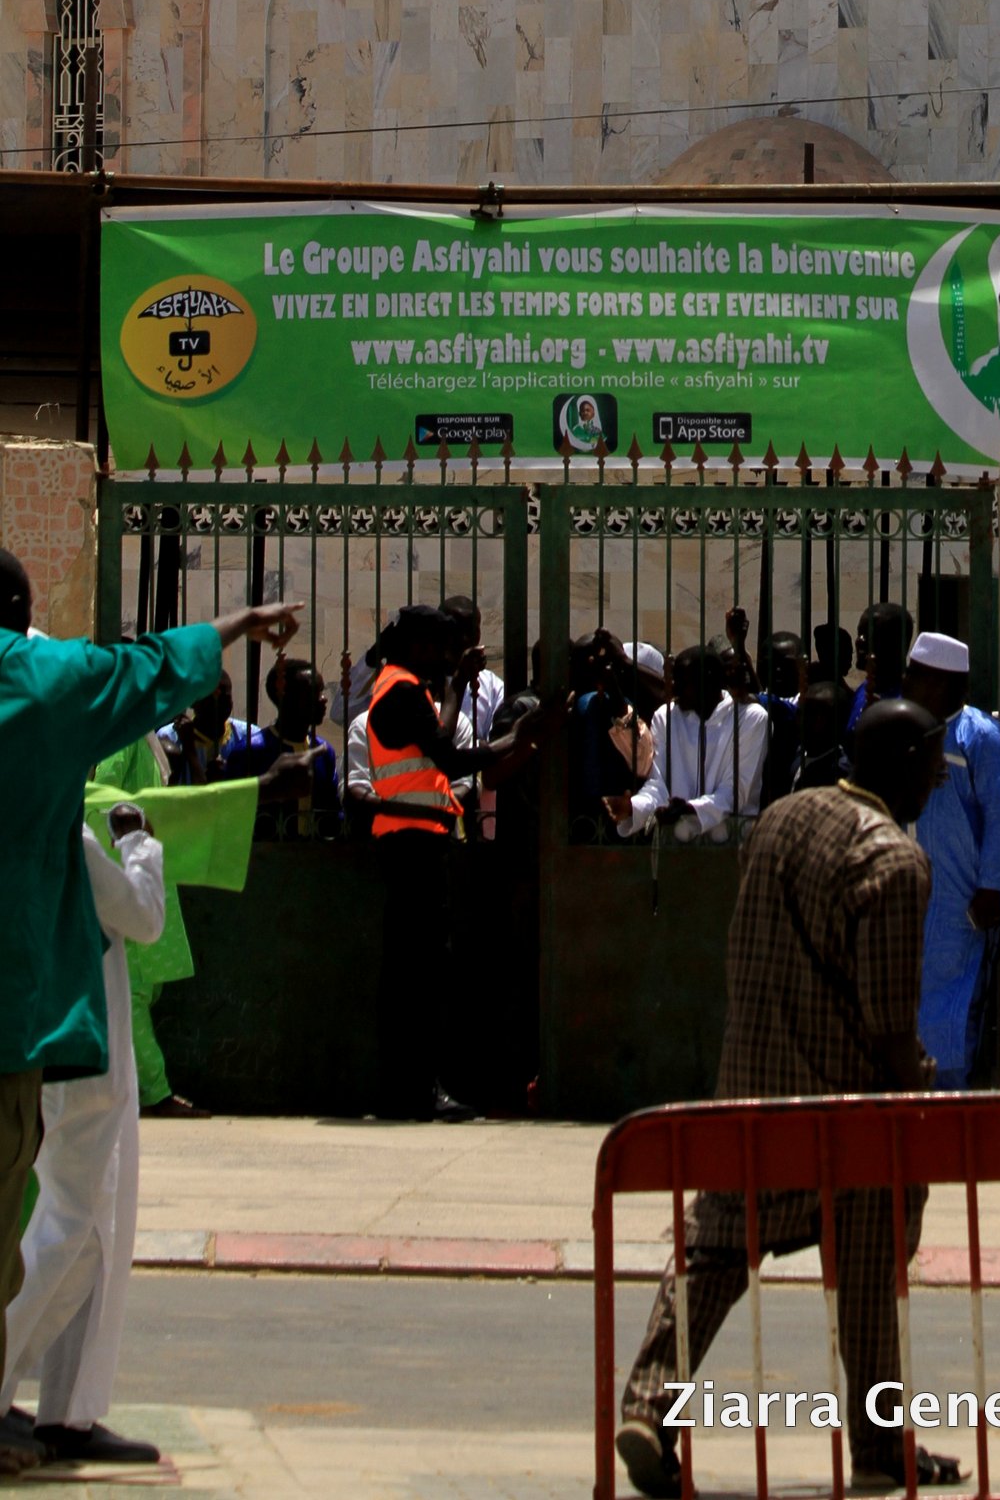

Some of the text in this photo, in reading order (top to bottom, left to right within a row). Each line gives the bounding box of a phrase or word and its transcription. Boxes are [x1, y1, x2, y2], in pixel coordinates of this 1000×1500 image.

[264, 240, 916, 280] Le Groupe Asfiyahi vous souhaite la bienvenue
[272, 291, 899, 320] VIVEZ EN DIRECT LES TEMPS FORTS DE CET EVENEMENT SUR
[179, 338, 200, 350] TV
[351, 332, 586, 370] www.asfiyahi.org
[612, 332, 829, 370] www.asfiyahi.tv
[367, 372, 477, 392] Téléchargez
[482, 371, 595, 392] l'application
[601, 372, 664, 388] mobile
[684, 371, 753, 392] asfiyahi
[773, 376, 800, 388] sur
[677, 417, 721, 426] Disponible
[437, 426, 482, 442] Google
[677, 425, 745, 441] App Store
